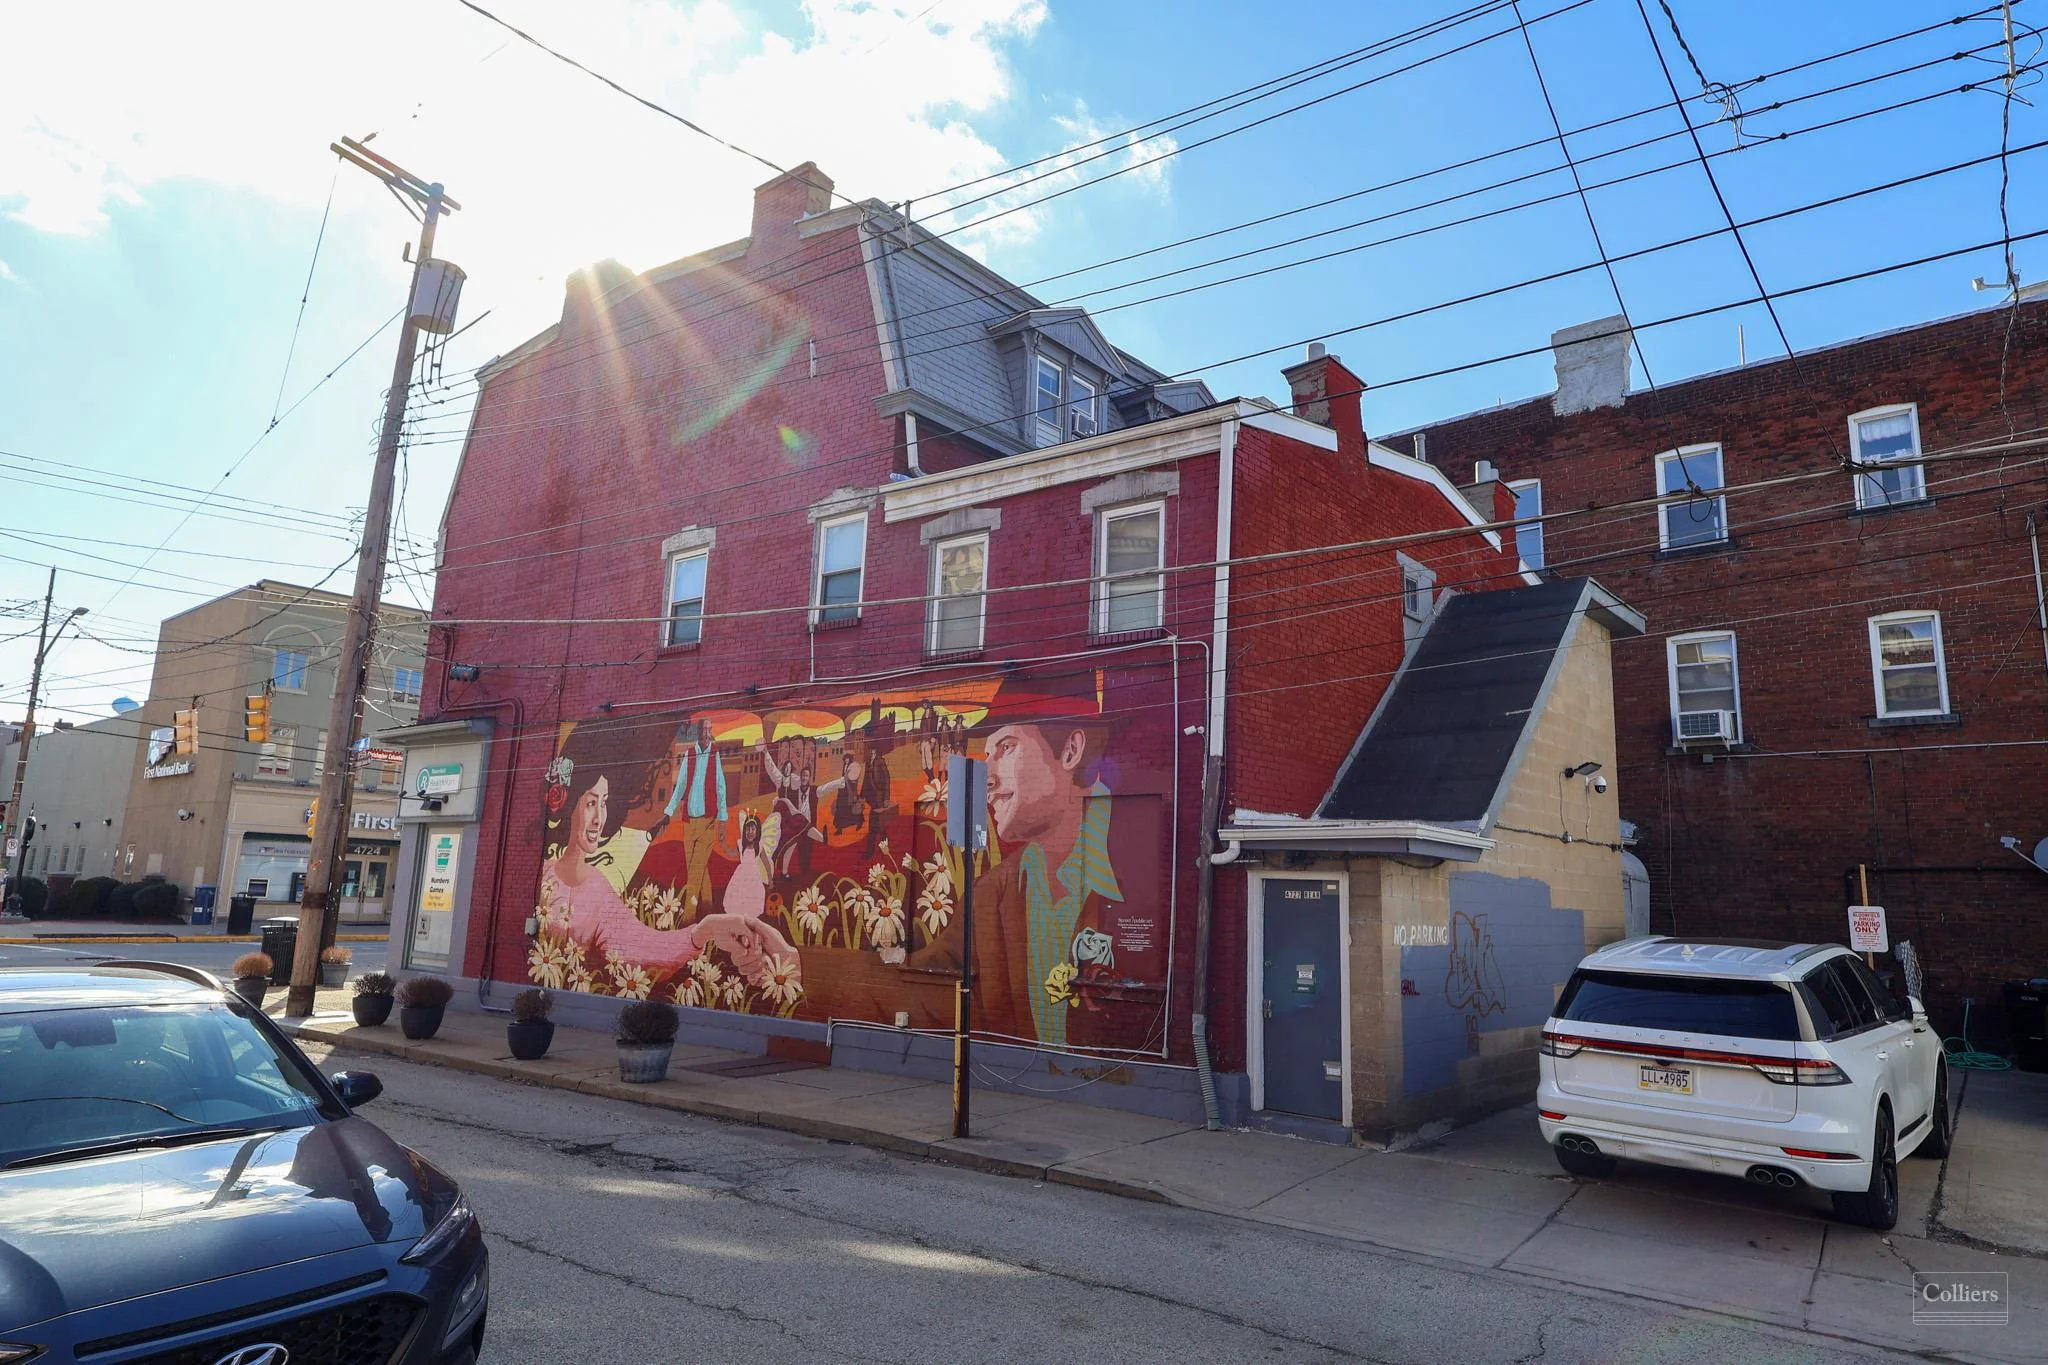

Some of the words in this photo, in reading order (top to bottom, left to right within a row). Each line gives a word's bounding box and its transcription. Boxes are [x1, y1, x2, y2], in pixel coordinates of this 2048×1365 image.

[144, 766, 155, 779] First
[155, 763, 175, 777] National
[175, 761, 190, 775] Bank
[353, 812, 397, 830] First
[353, 845, 381, 855] 4724
[429, 886, 444, 894] Games
[1393, 924, 1408, 946] NO
[1410, 924, 1448, 945] PARKING
